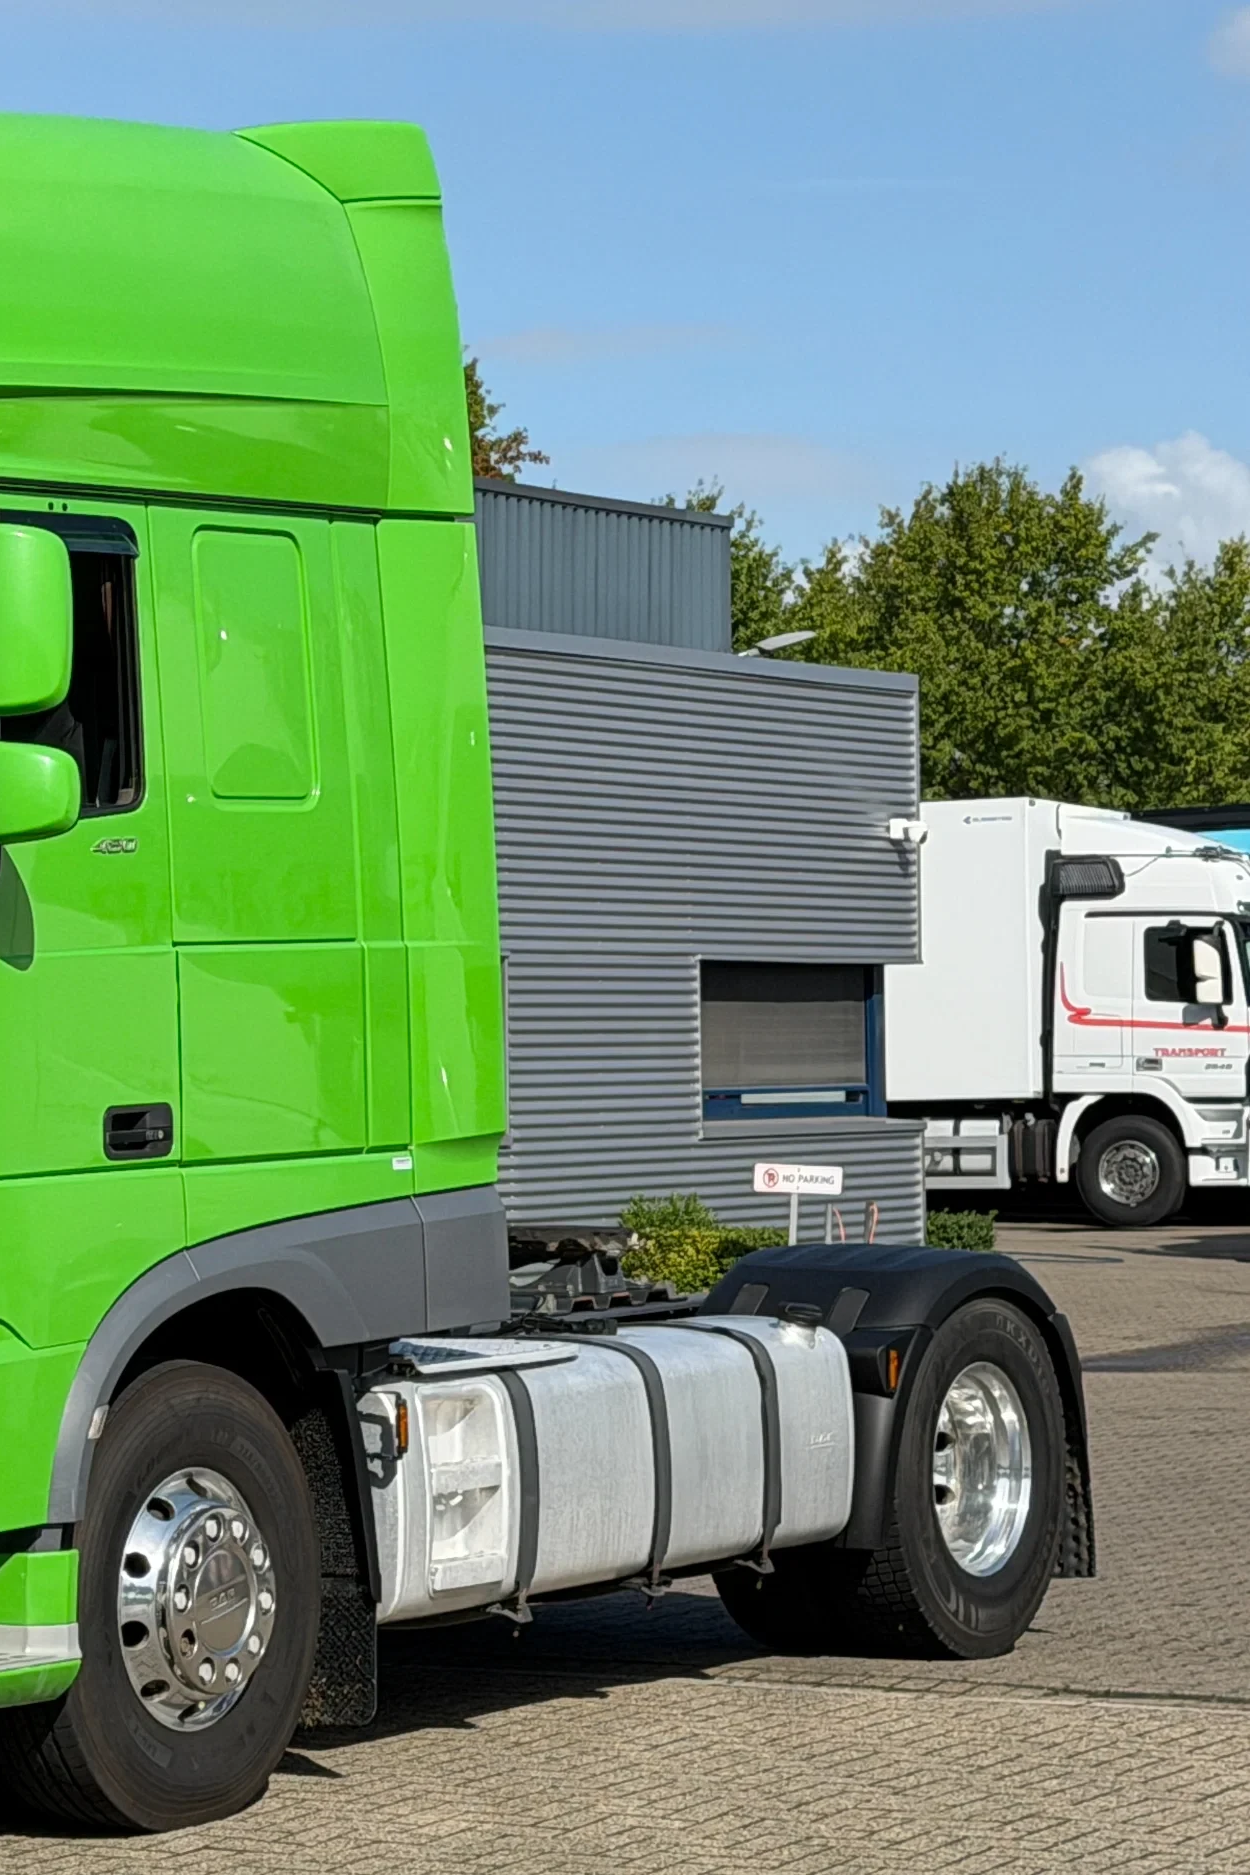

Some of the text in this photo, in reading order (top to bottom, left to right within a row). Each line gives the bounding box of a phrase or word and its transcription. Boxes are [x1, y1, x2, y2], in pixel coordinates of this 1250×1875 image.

[1153, 1047, 1227, 1057] TRANSPORT
[782, 1174, 835, 1185] NO PARKING
